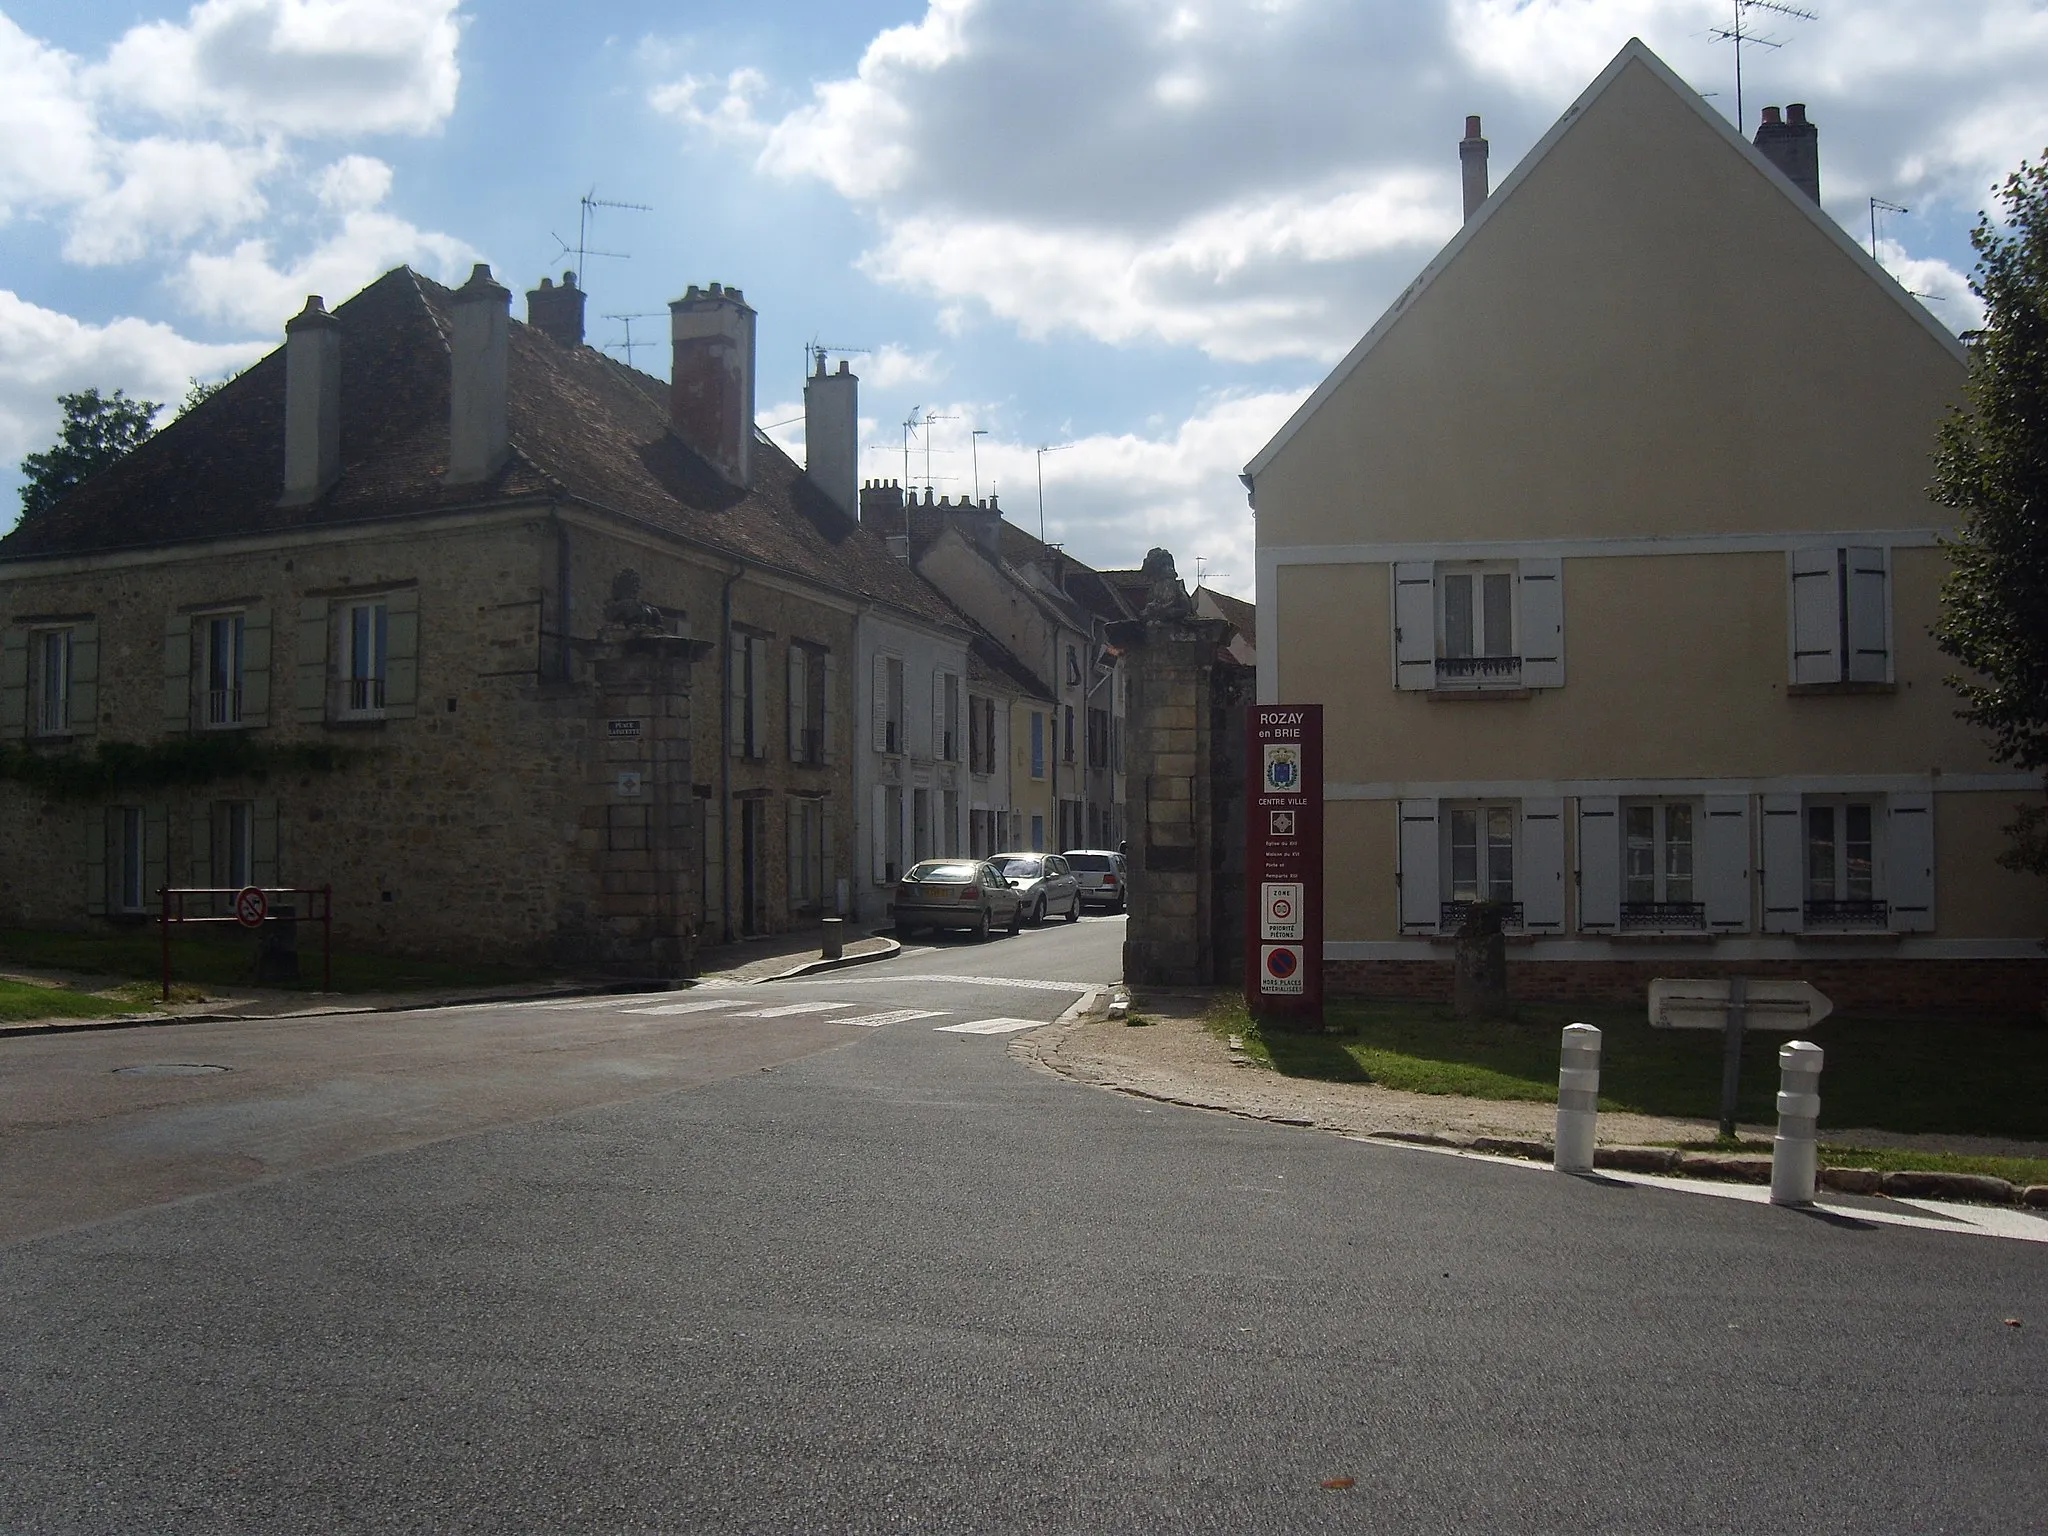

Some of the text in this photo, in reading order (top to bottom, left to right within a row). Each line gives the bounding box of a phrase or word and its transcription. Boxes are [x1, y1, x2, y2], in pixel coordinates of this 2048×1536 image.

[1260, 713, 1304, 724] ROZAY
[1258, 728, 1301, 738] en BRIE
